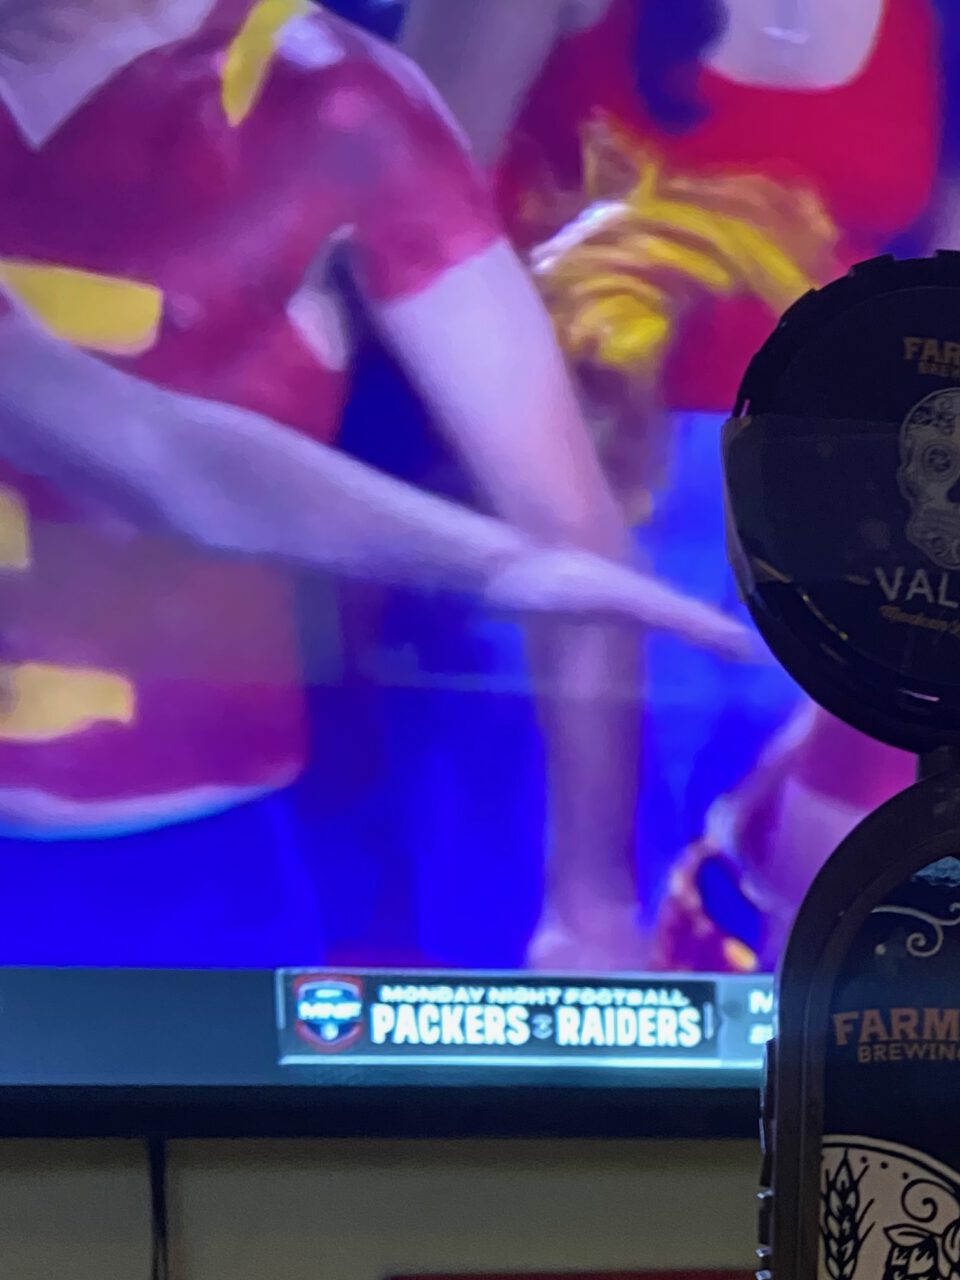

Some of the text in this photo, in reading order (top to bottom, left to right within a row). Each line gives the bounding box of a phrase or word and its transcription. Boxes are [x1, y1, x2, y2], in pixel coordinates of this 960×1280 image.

[378, 985, 691, 1007] MONDAY NIGHT FOOTBALL
[369, 1002, 531, 1046] PACKERS
[555, 1005, 702, 1048] RAIDERS
